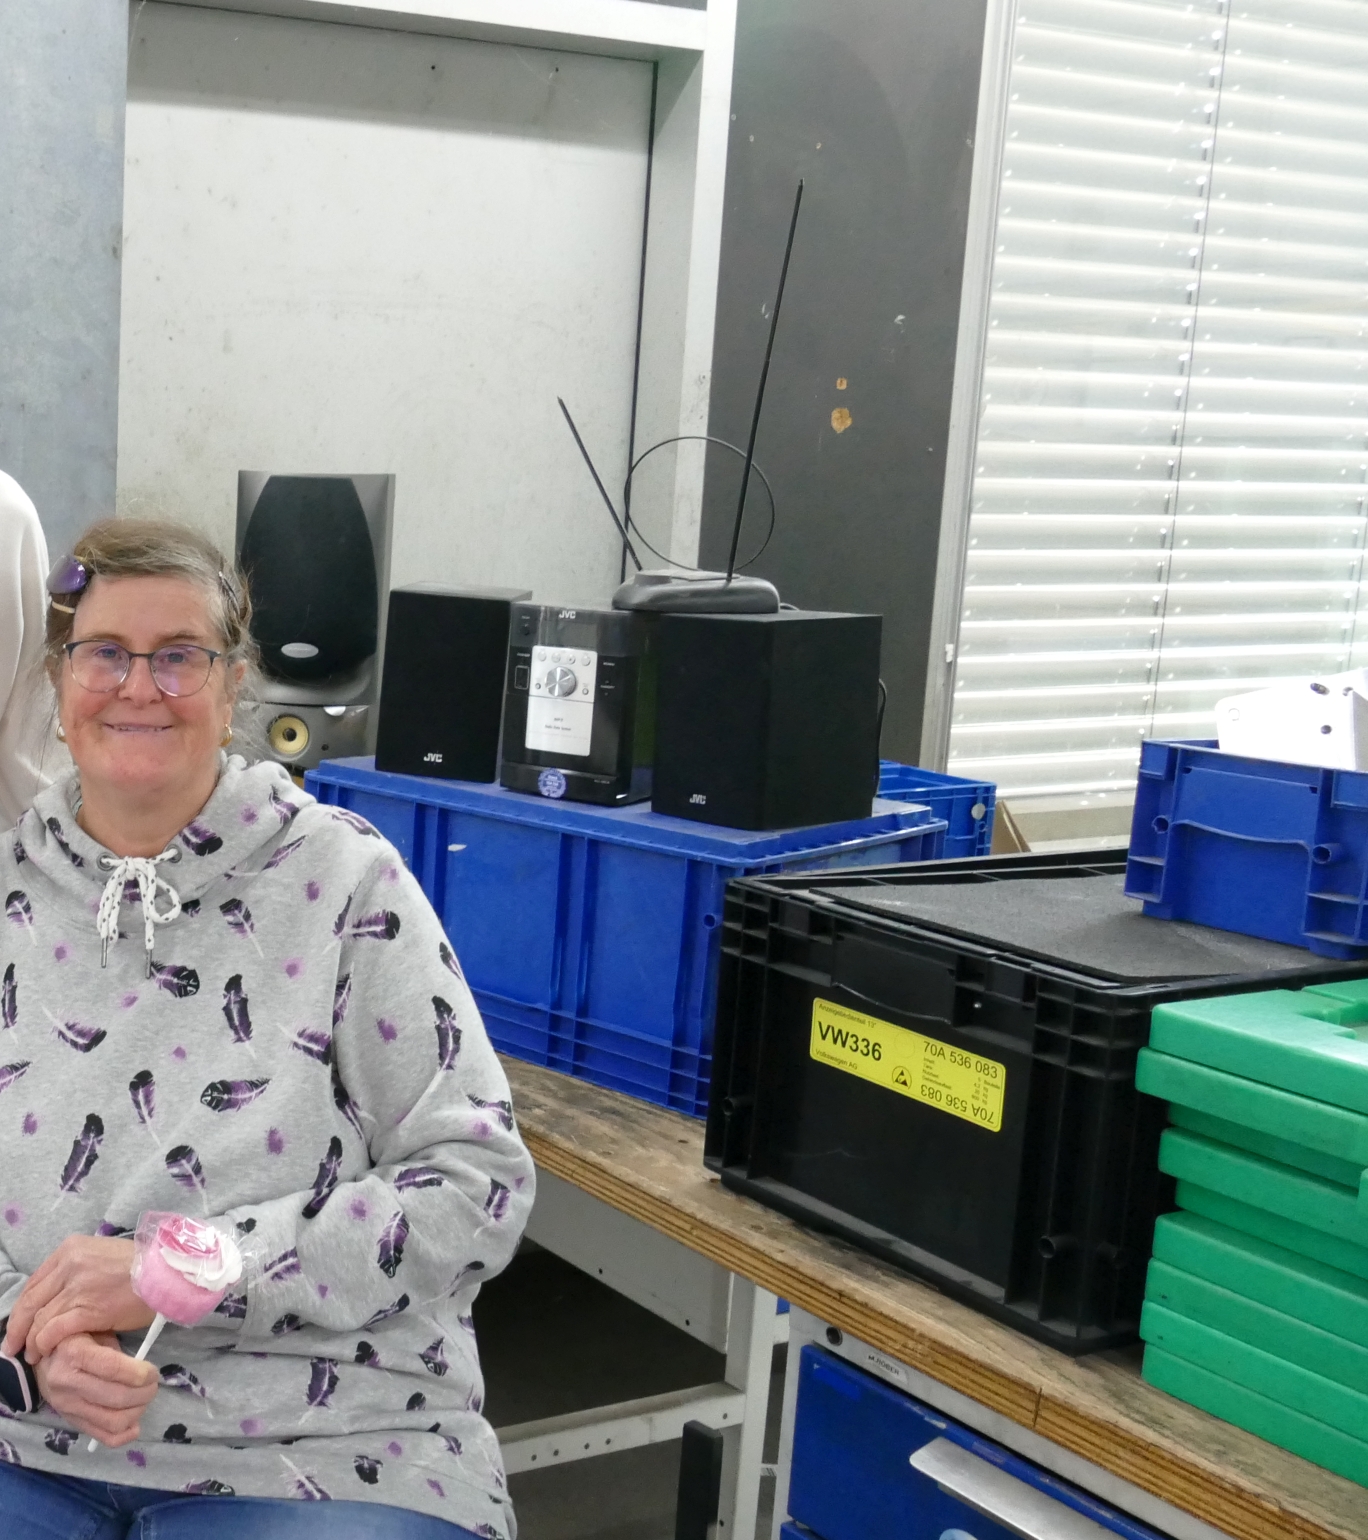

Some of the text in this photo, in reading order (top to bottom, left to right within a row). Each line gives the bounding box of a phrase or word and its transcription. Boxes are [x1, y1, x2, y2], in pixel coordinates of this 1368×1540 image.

[558, 610, 576, 619] JVC
[423, 752, 443, 763] JVC
[689, 793, 707, 805] JVC
[818, 1021, 882, 1062] VW336
[848, 1061, 859, 1070] AG
[923, 1040, 998, 1079] 70A 536 083
[920, 1084, 943, 1103] 083
[945, 1093, 968, 1113] 536
[972, 1103, 995, 1124] 70A
